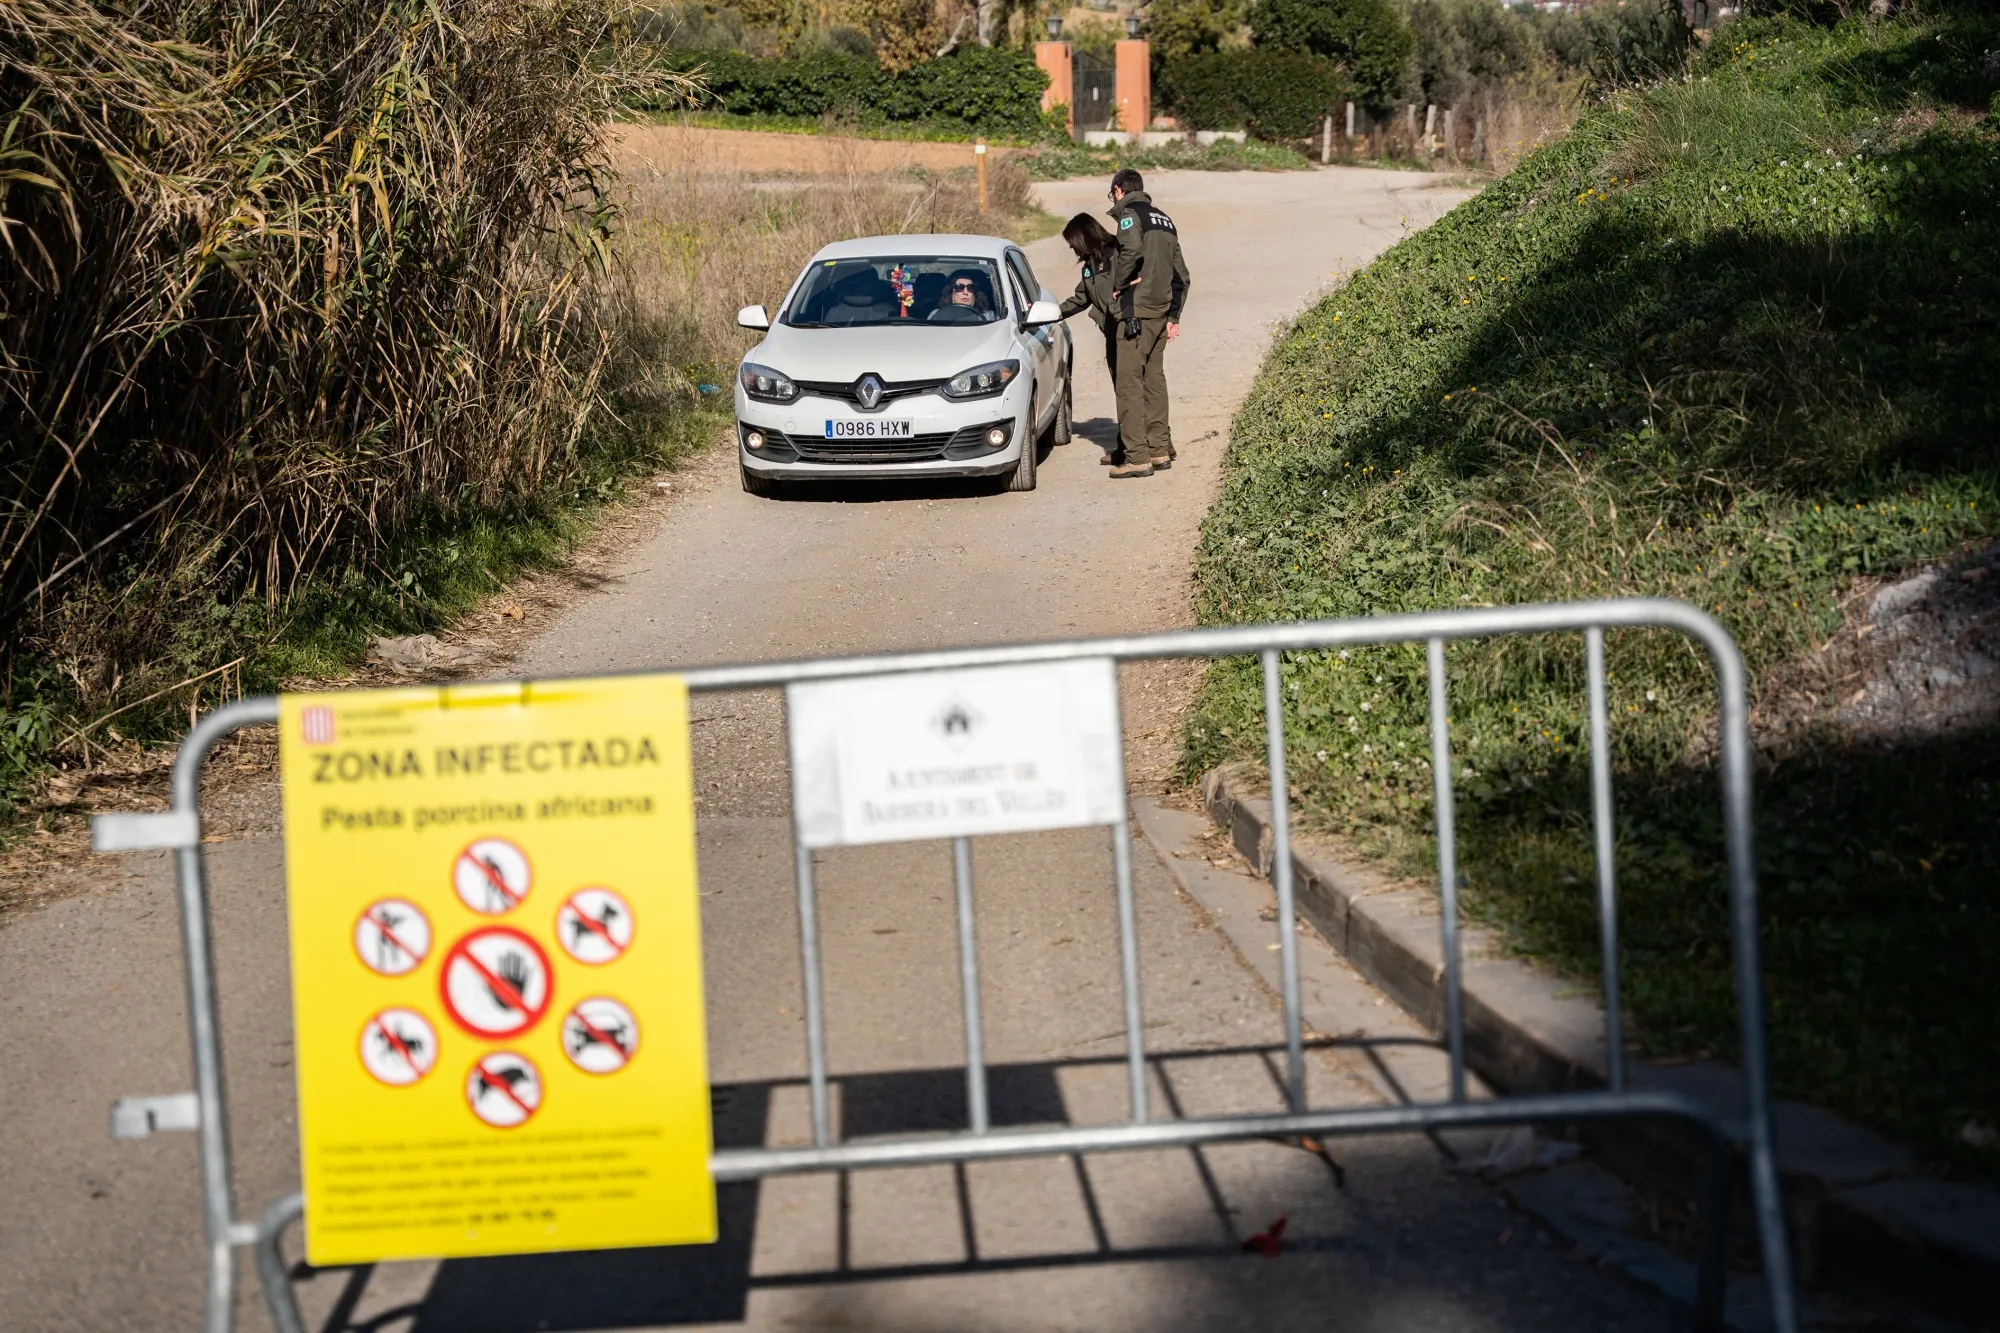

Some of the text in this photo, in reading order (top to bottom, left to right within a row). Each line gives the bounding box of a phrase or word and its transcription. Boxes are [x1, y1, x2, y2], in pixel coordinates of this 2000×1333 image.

[836, 421, 910, 436] 0986 HXW
[312, 737, 660, 783] ZONA INFECTADA
[321, 794, 655, 831] Pesta porcina africana
